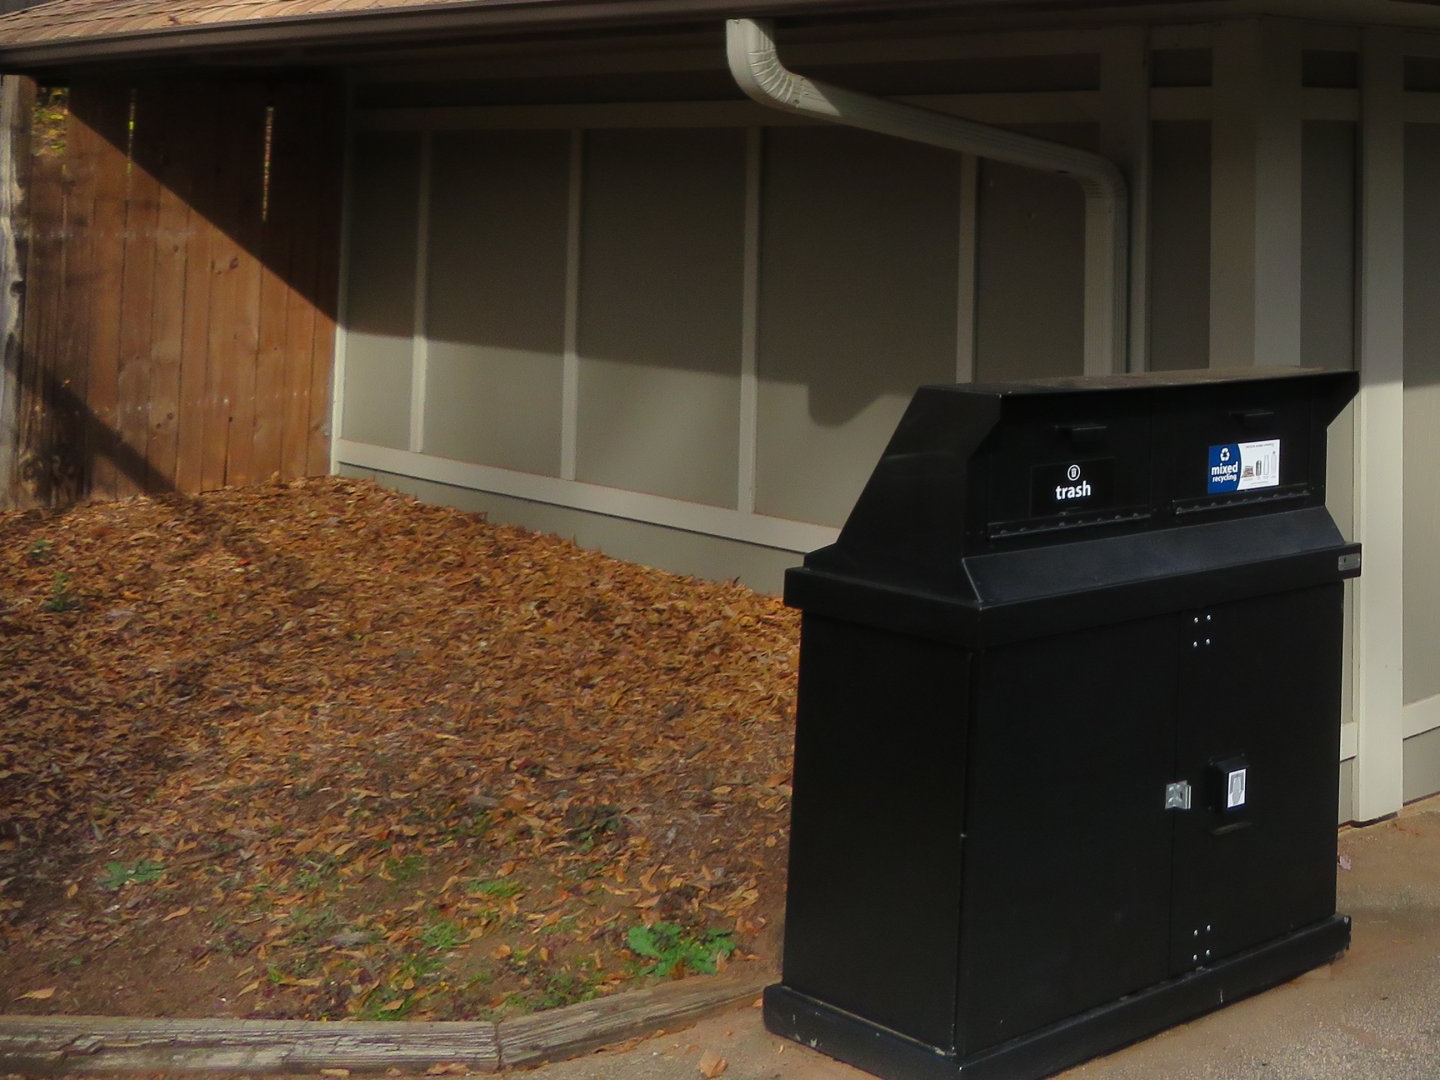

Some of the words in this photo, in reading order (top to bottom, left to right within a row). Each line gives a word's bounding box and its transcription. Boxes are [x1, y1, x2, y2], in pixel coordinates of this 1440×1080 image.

[1211, 461, 1238, 475] mixed
[1212, 474, 1237, 484] recycling
[1056, 481, 1091, 500] trash
